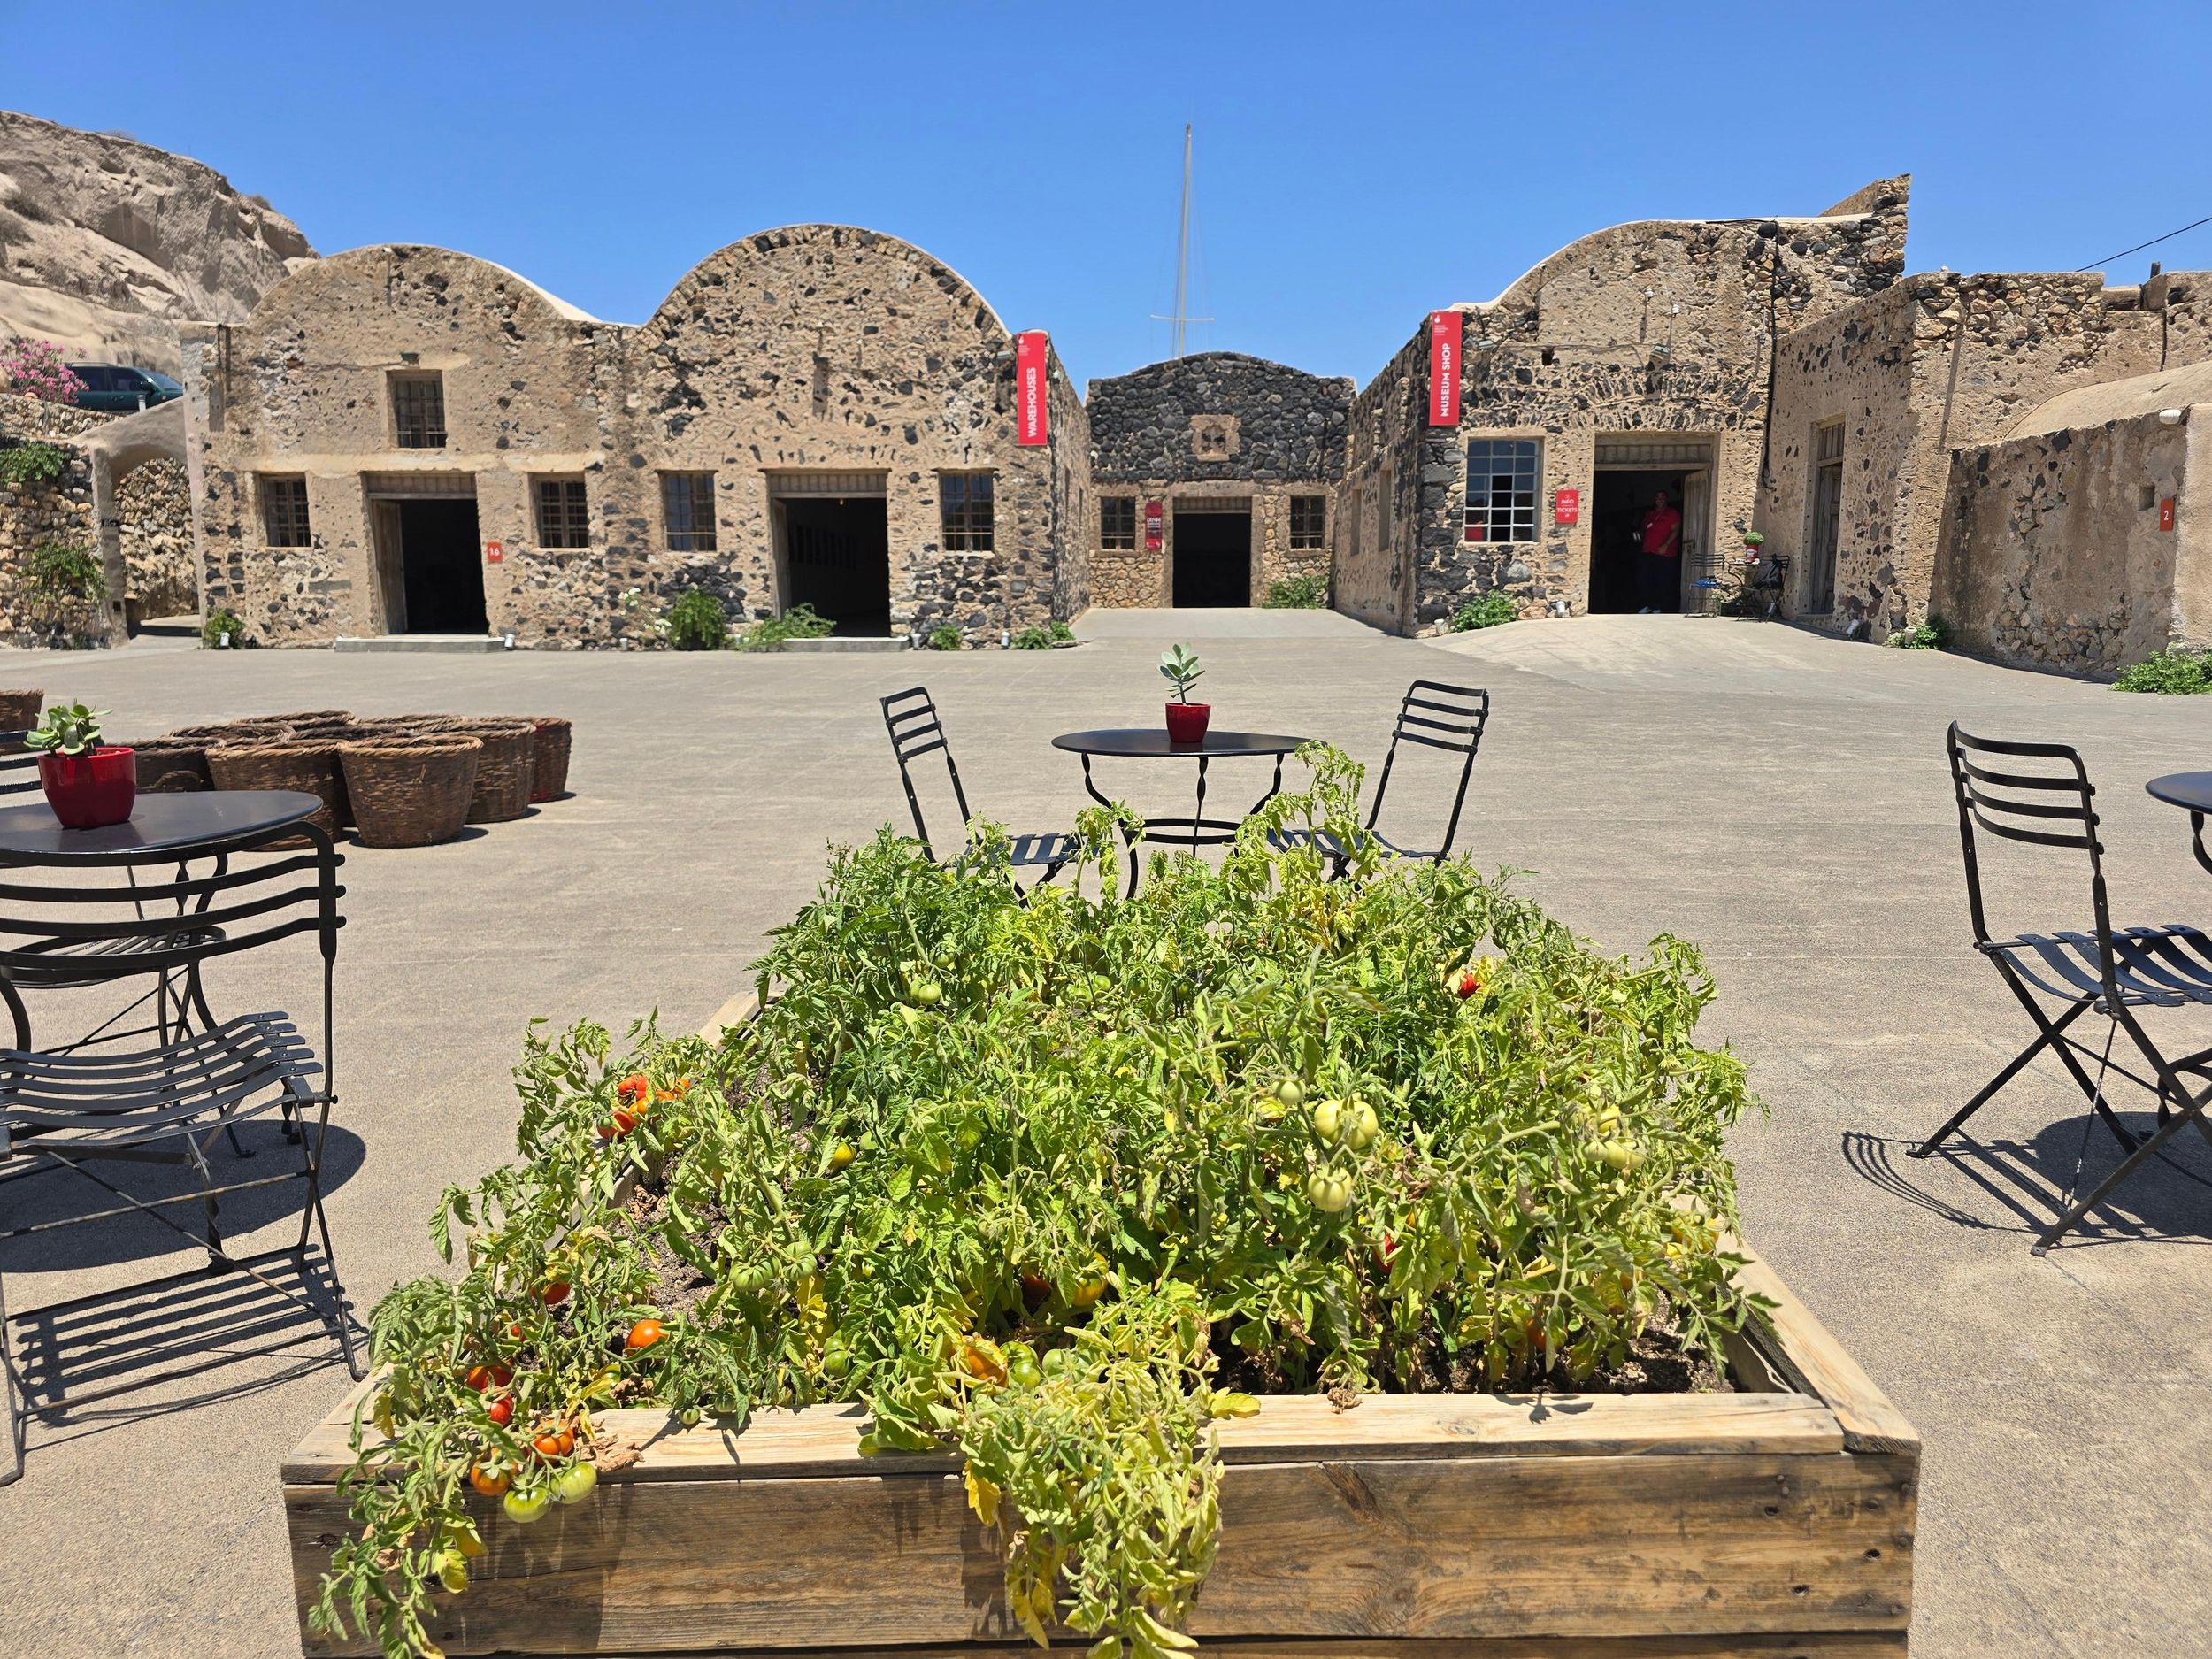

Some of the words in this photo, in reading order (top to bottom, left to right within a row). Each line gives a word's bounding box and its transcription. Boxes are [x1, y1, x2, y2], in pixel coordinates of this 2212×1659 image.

[1441, 342, 1451, 371] SHOP
[1026, 367, 1038, 438] WAREHOUSES
[1440, 373, 1451, 417] MUSEUM
[2163, 510, 2170, 521] 2
[489, 547, 500, 557] 16
